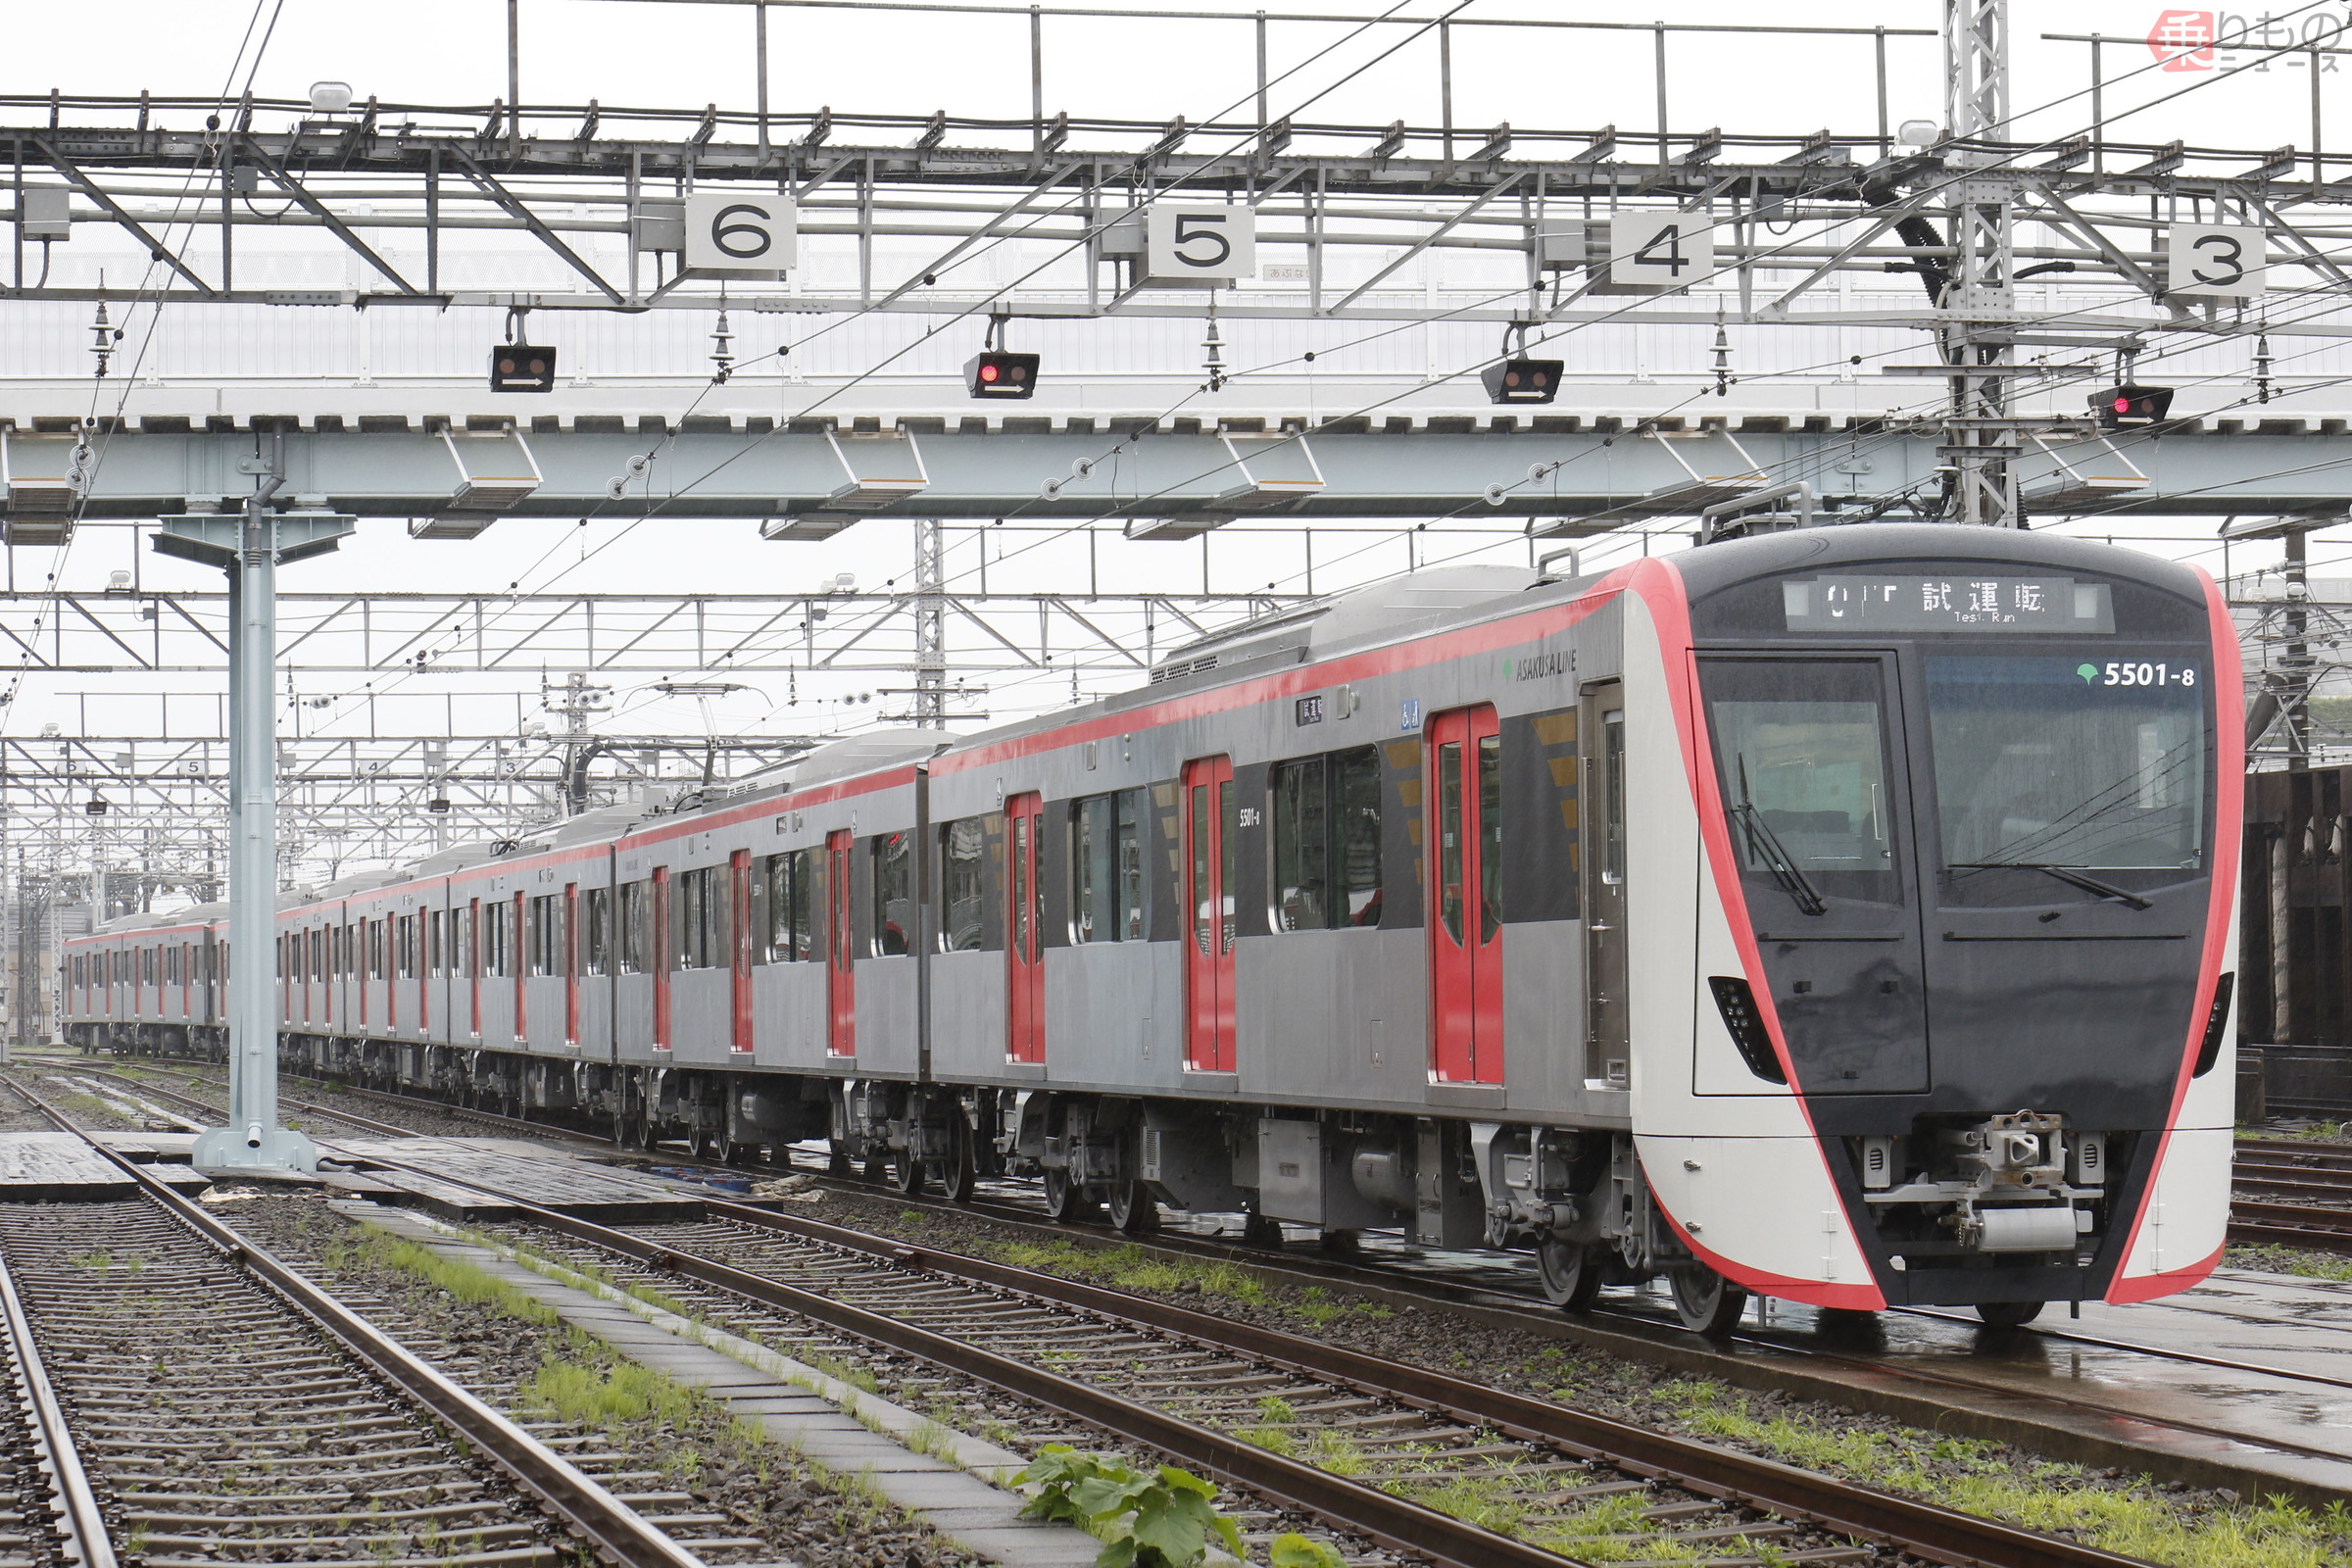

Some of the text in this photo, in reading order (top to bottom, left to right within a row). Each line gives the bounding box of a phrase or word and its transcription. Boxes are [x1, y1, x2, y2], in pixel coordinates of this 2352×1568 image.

[711, 204, 771, 259] 6
[1174, 214, 1231, 268] 5
[1634, 222, 1690, 277] 4
[2191, 234, 2243, 286] 3
[1921, 581, 2045, 612] 試運転
[1516, 648, 1577, 682] ASAKUSA LINE
[2103, 662, 2195, 687] 5501-8
[188, 761, 199, 772] 5
[368, 761, 378, 771] 4
[506, 762, 515, 773] 3
[1240, 808, 1260, 828] 5501-8
